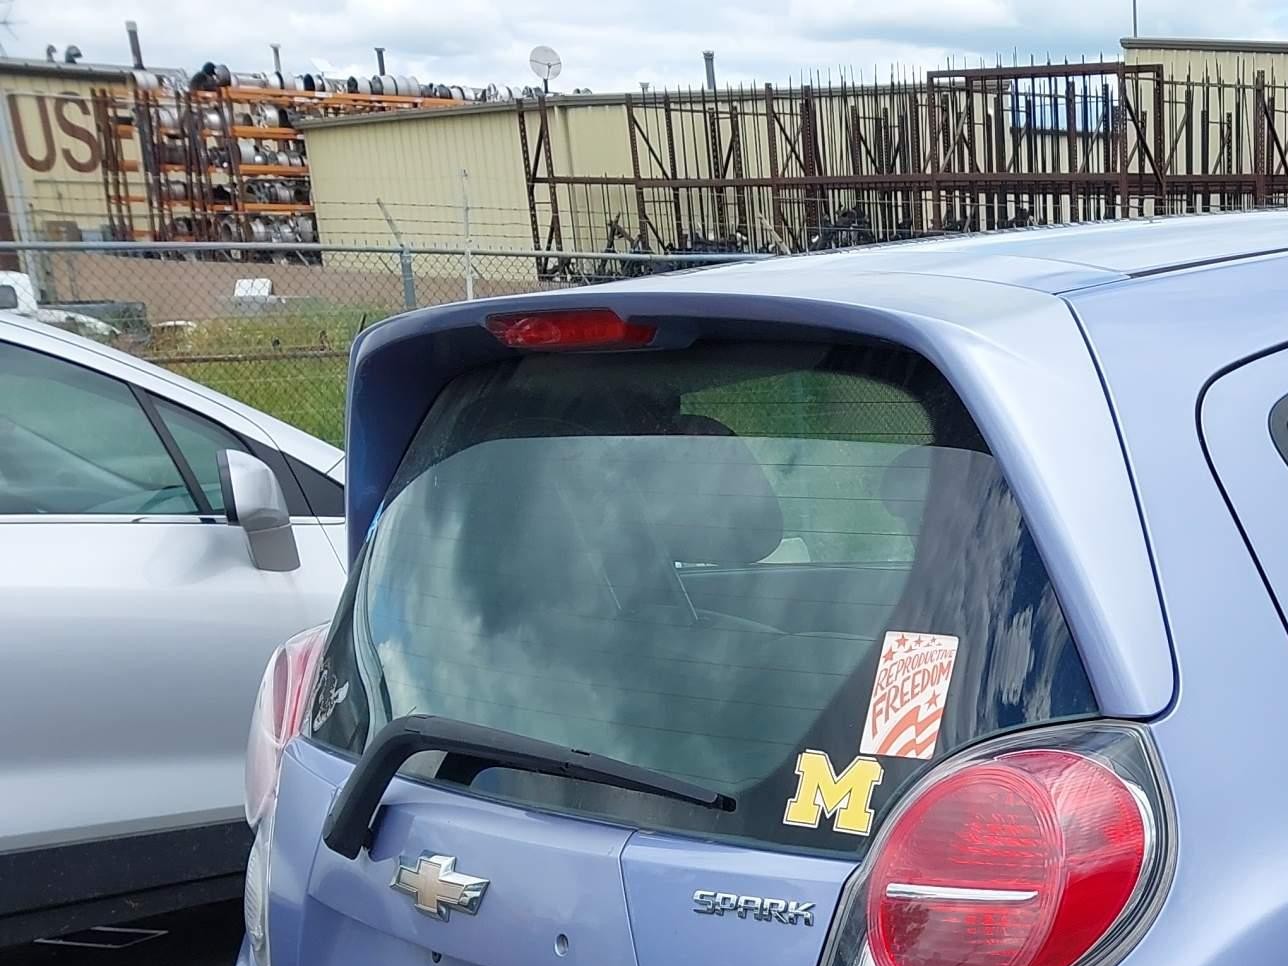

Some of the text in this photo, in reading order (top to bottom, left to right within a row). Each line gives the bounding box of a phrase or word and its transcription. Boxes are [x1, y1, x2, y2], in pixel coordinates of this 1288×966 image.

[871, 660, 953, 739] FREEDOM
[874, 648, 956, 698] REPRODUCTIVE
[783, 749, 884, 837] M
[692, 889, 817, 927] SPARK
